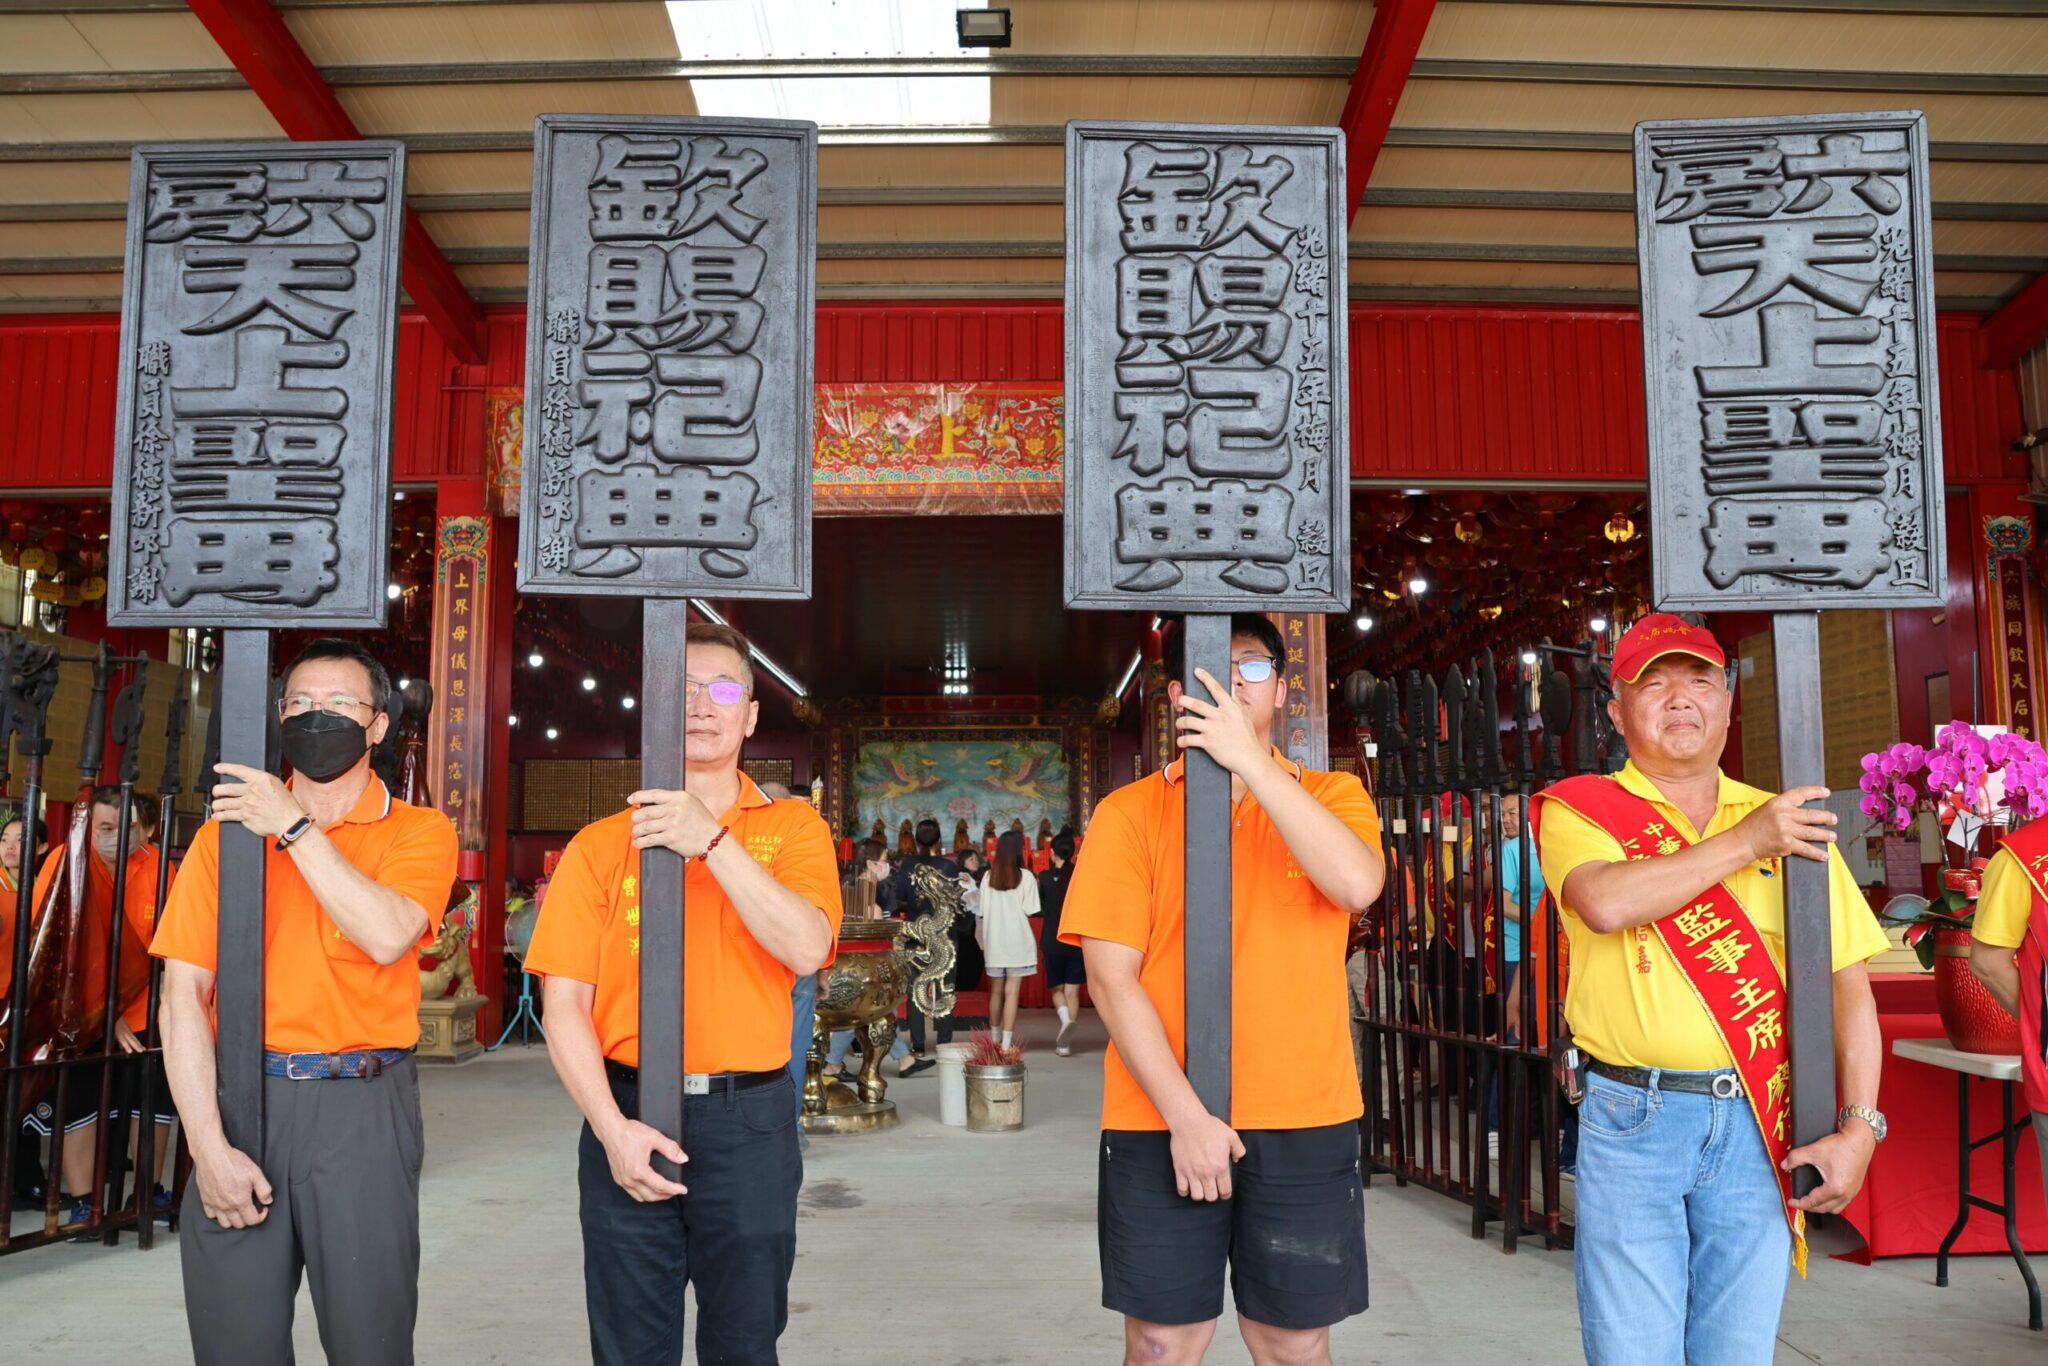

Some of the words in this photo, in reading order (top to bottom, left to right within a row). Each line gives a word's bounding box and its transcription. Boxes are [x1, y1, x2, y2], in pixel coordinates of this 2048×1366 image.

[573, 134, 768, 578] 欽賜祀典
[1113, 142, 1296, 594] 欽賜祀典
[1672, 902, 1784, 1060] 監事主席
